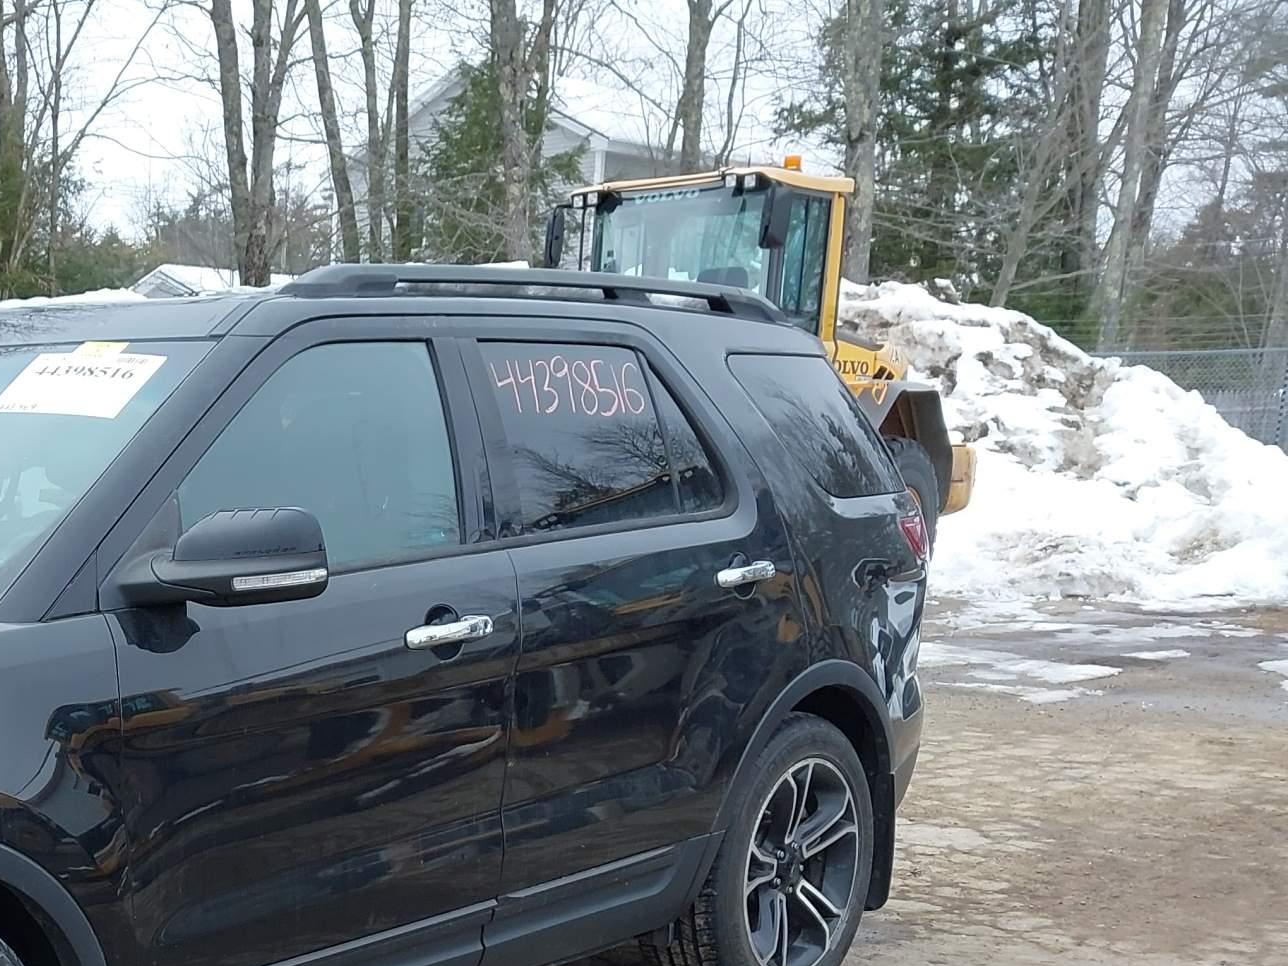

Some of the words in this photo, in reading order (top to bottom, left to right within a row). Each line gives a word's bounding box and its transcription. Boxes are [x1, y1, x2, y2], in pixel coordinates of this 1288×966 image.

[632, 188, 701, 205] VOLVO
[34, 365, 135, 380] 44398516
[835, 359, 869, 375] OLVO
[490, 355, 646, 417] 44398516
